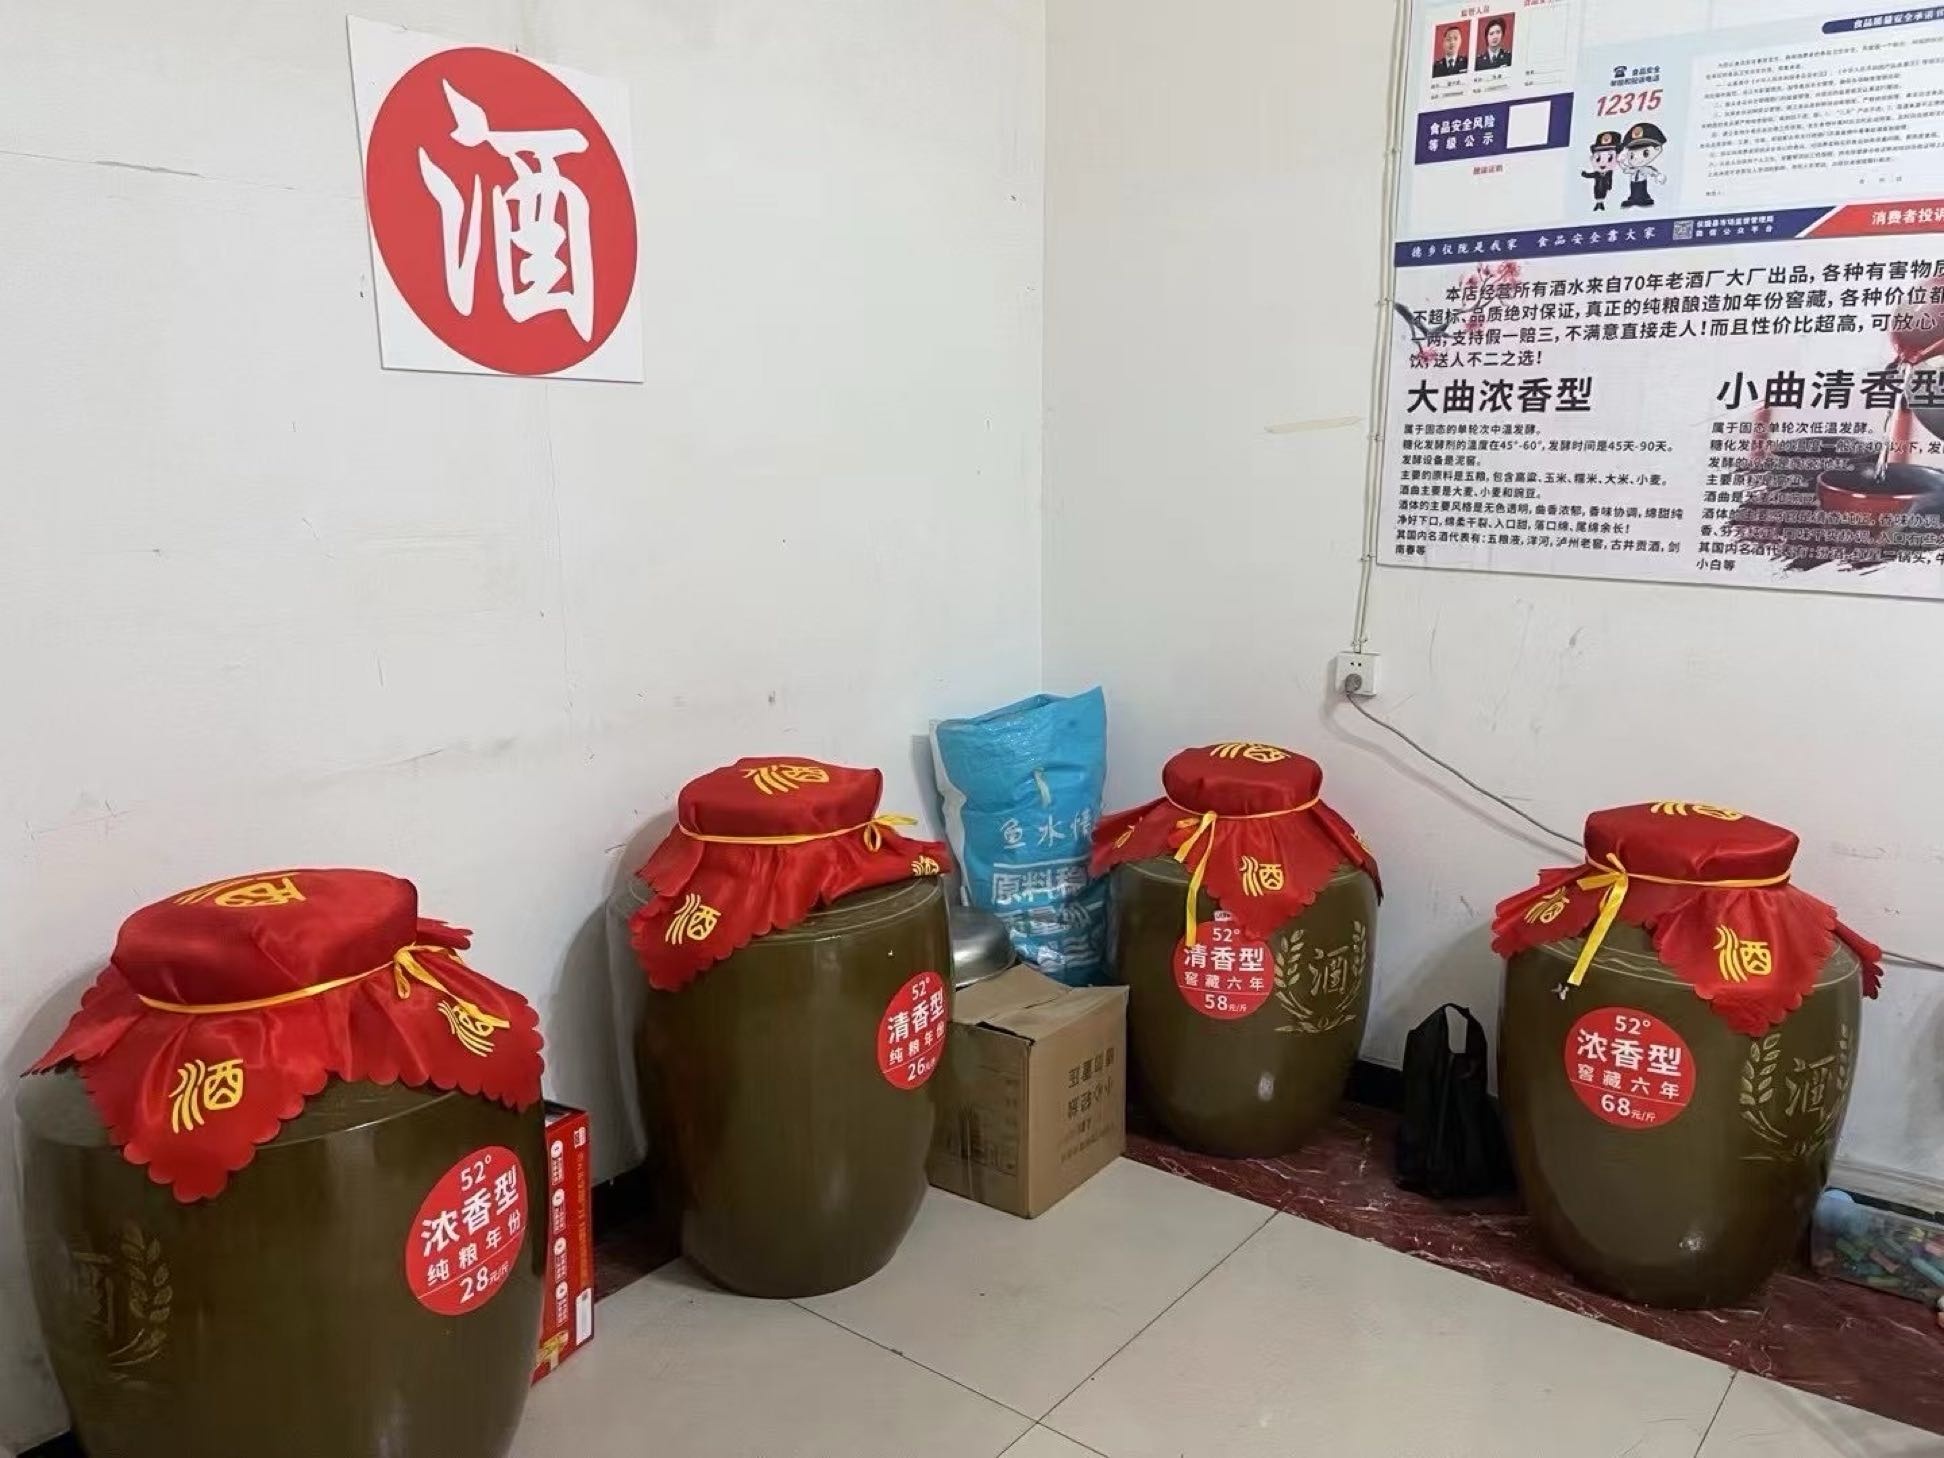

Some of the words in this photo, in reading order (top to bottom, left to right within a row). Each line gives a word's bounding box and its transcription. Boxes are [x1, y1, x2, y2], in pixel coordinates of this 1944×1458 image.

[1597, 89, 1663, 116] 12315
[1427, 131, 1494, 152] 等级公示
[1430, 114, 1496, 136] 食品安全风险
[417, 77, 590, 342] 酒
[1407, 376, 1592, 414] 大曲浓香型
[1716, 369, 1944, 410] 小曲清香型
[1696, 559, 1736, 572] 小白等
[1240, 856, 1284, 896] 酒
[1212, 928, 1240, 943] 52°
[1713, 925, 1772, 983] 酒
[1184, 947, 1265, 973] 清香型
[912, 977, 931, 1001] 52°
[1184, 971, 1264, 990] 窖藏六年
[887, 987, 945, 1044] 清香型
[1615, 1015, 1651, 1034] 52°
[1577, 1028, 1682, 1078] 浓香型
[168, 1058, 243, 1133] 酒
[1577, 1063, 1680, 1100] 窖藏六年
[460, 1154, 492, 1192] 52°
[421, 1164, 519, 1258] 浓香型
[428, 1210, 521, 1287] 纯粮年份
